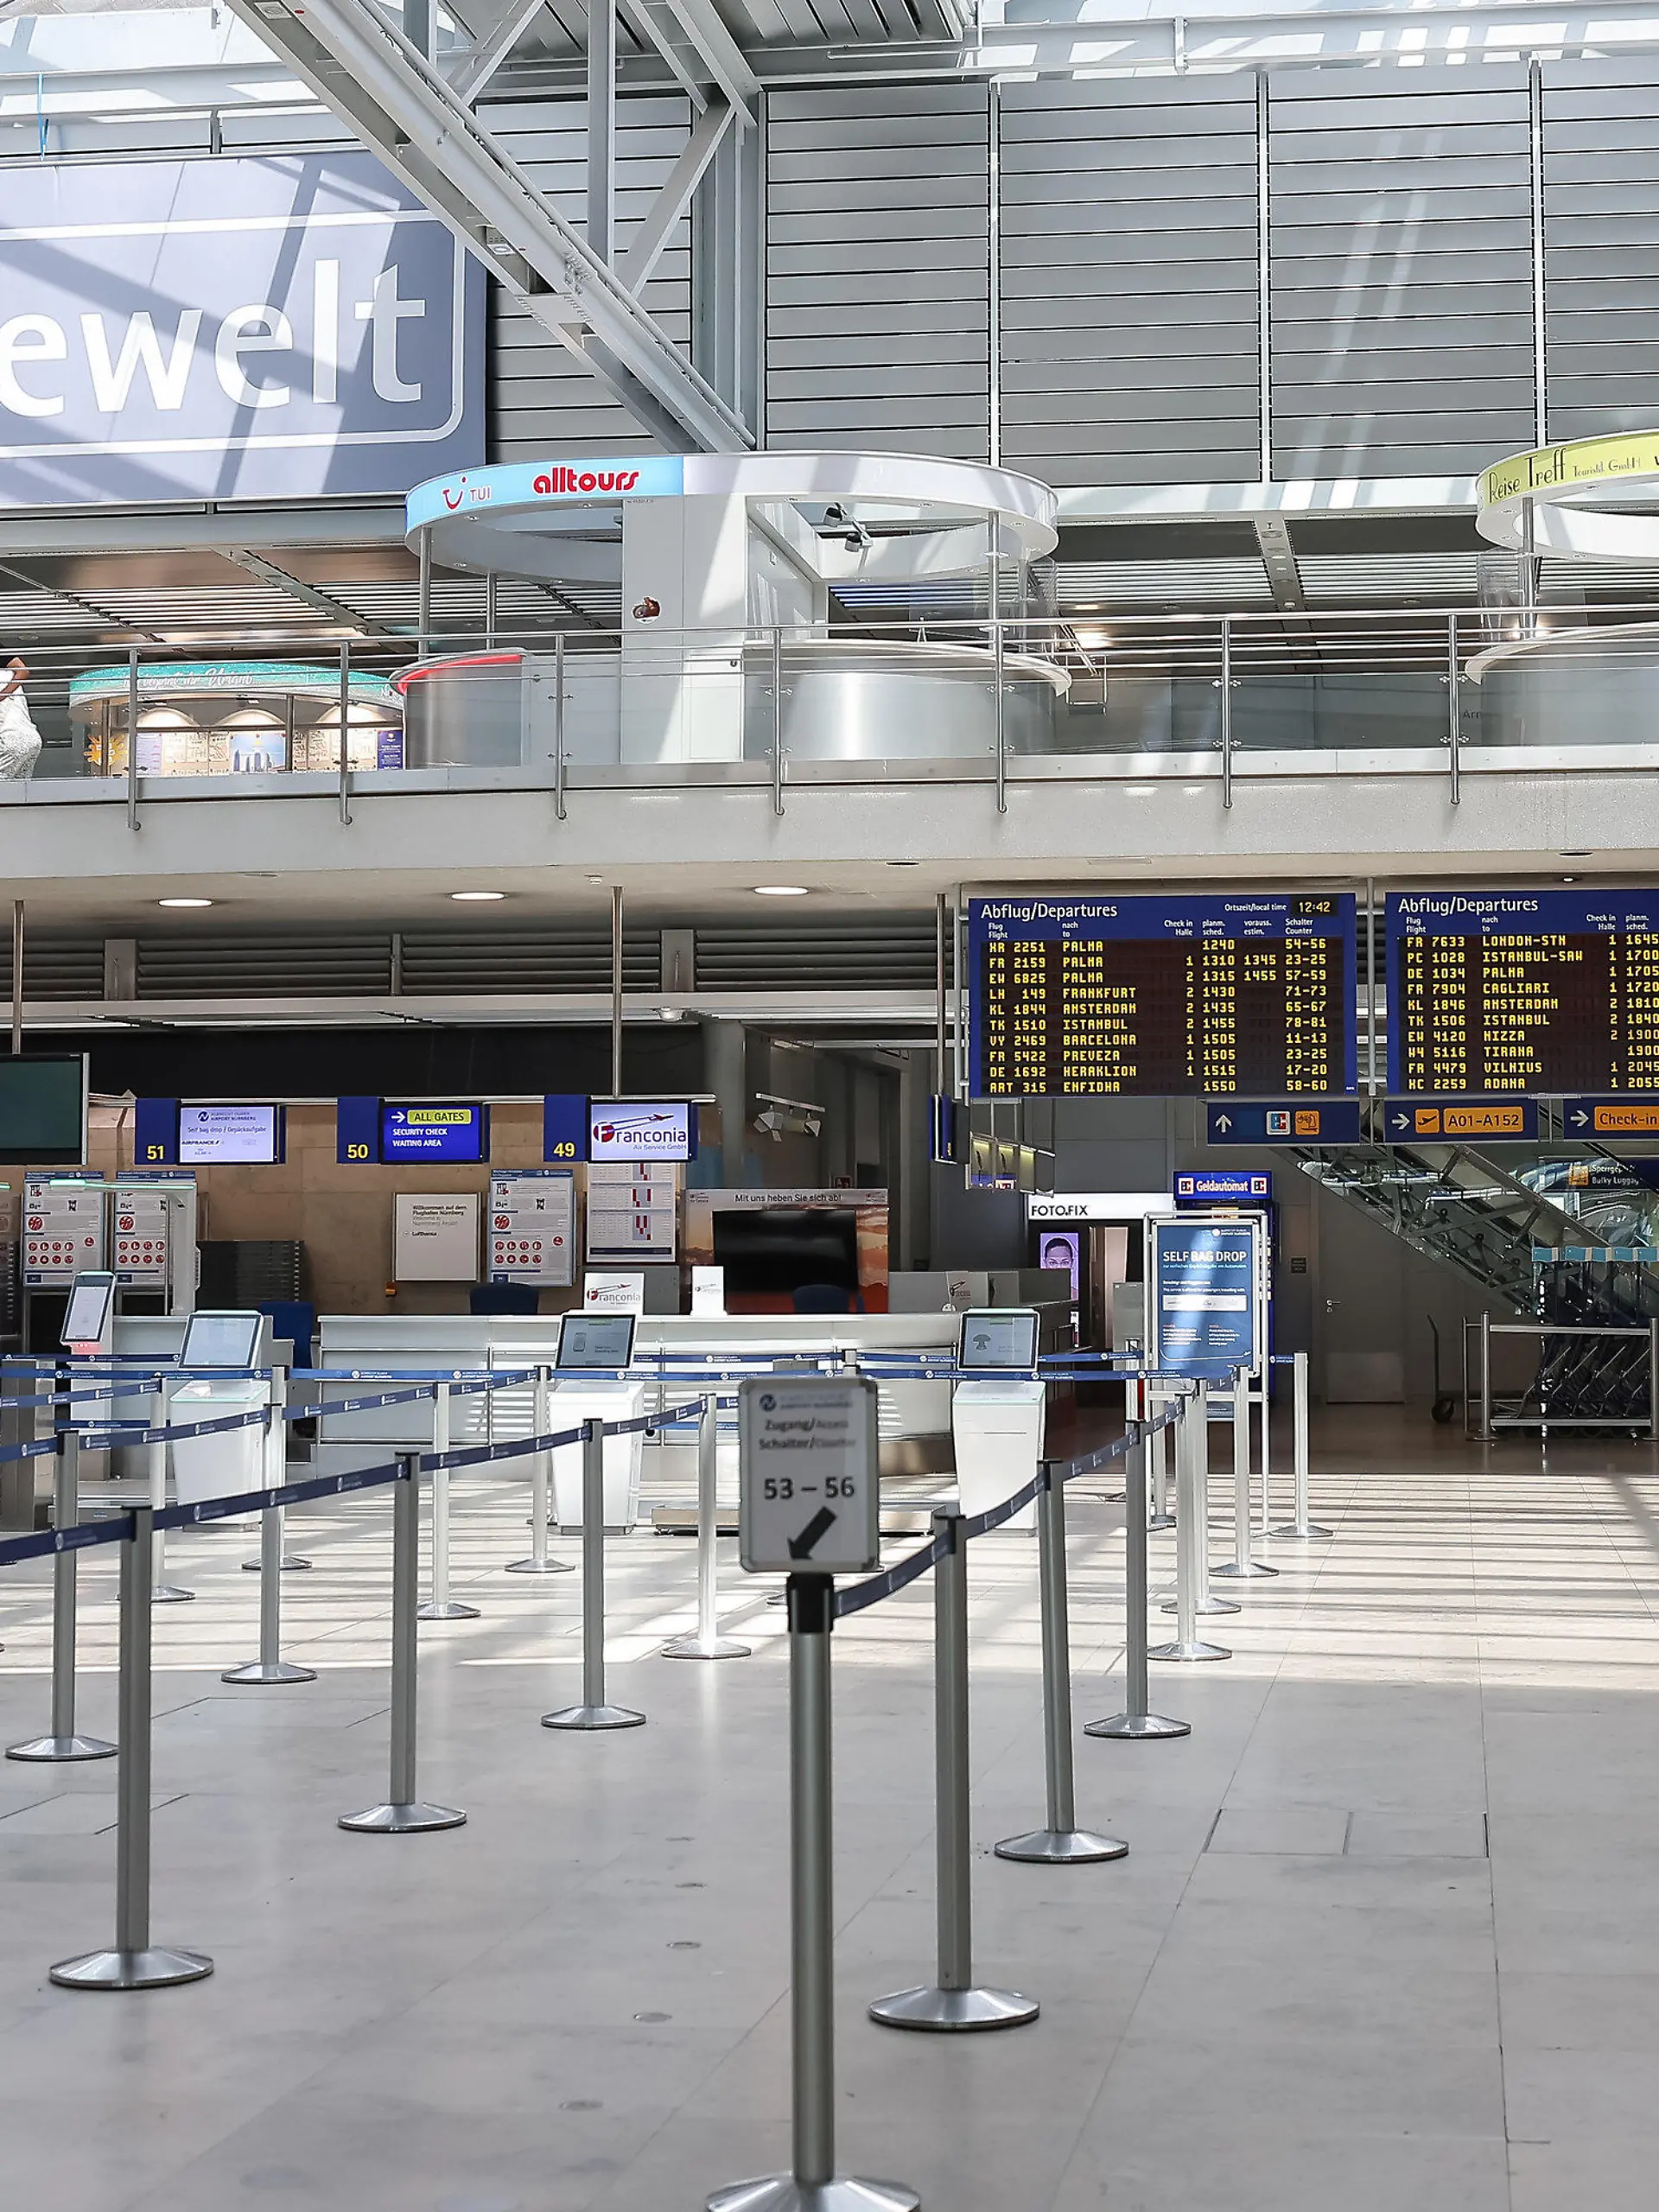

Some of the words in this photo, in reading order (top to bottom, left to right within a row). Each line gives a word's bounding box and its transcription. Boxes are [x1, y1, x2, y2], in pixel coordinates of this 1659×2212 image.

[0, 258, 426, 418] ewelt
[533, 467, 639, 494] alltours
[1489, 471, 1521, 504] Reise
[1524, 448, 1567, 487] Treff
[470, 485, 491, 501] TUI
[981, 902, 1117, 922] Abflug/Departures
[1299, 901, 1331, 912] 12:42
[1398, 897, 1538, 916] Abflug/Departures
[988, 923, 1003, 931] Flug
[988, 931, 1008, 939] Flight
[1407, 936, 1423, 948] FR
[1432, 936, 1465, 948] 7633
[1482, 934, 1566, 947] LONDON-STN
[1626, 933, 1659, 945] 1645
[1014, 941, 1046, 953] 2251
[1062, 940, 1103, 952] PALMA
[1202, 939, 1235, 950] 1240
[1285, 938, 1326, 950] 54-56
[989, 957, 1005, 969] FR
[1014, 957, 1046, 969] 2159
[1063, 956, 1103, 968] PALMA
[1203, 955, 1235, 966] 1310
[1243, 954, 1276, 965] 1345
[1285, 953, 1326, 965] 23-25
[1407, 952, 1423, 964] PC
[1432, 951, 1465, 963] 1028
[1482, 950, 1583, 963] ISTANBUL-SAW
[1626, 949, 1659, 961] 1700
[1014, 972, 1046, 984] 6825
[1063, 971, 1103, 983] PALMA
[1203, 970, 1236, 982] 1315
[1243, 969, 1276, 982] 1455
[1286, 969, 1326, 981] 57-59
[1407, 968, 1423, 979] DE
[1432, 967, 1465, 979] 1034
[1483, 967, 1524, 979] PALMA
[1626, 965, 1659, 976] 1705
[989, 988, 1005, 1000] LH
[1022, 988, 1046, 1000] 149
[1063, 987, 1136, 1000] FRANKFURT
[1203, 986, 1236, 997] 1430
[1286, 985, 1326, 997] 71-73
[1408, 983, 1423, 995] FR
[1433, 983, 1465, 995] 7904
[1483, 982, 1549, 995] CAGLIARI
[1626, 981, 1659, 993] 1720
[989, 1004, 1005, 1015] KL
[1014, 1003, 1046, 1015] 1844
[1063, 1002, 1136, 1015] AMSTERDAM
[1203, 1001, 1236, 1014] 1435
[1286, 1001, 1327, 1013] 65-67
[1408, 999, 1424, 1011] KL
[1433, 999, 1465, 1011] 1846
[1483, 998, 1558, 1010] AMSTERDAM
[1626, 997, 1659, 1008] 1810
[989, 1020, 1005, 1031] TK
[1014, 1019, 1046, 1031] 1510
[1063, 1018, 1128, 1031] ISTANBUL
[1203, 1017, 1236, 1029] 1455
[1286, 1016, 1327, 1028] 78-81
[1408, 1014, 1424, 1027] TK
[1433, 1014, 1465, 1027] 1506
[1483, 1014, 1550, 1026] ISTANBUL
[1627, 1013, 1659, 1025] 1840
[989, 1035, 1005, 1046] VY
[1014, 1034, 1046, 1046] 2469
[1063, 1033, 1136, 1046] BARCELONA
[1203, 1033, 1236, 1045] 1505
[1286, 1032, 1327, 1044] 11-13
[1433, 1030, 1466, 1042] 4120
[1484, 1030, 1525, 1042] NIZZA
[1627, 1029, 1659, 1040] 1900
[989, 1051, 1005, 1063] FR
[1014, 1051, 1046, 1062] 5422
[1063, 1050, 1120, 1062] PREVEZA
[1203, 1049, 1236, 1060] 1505
[1286, 1048, 1327, 1059] 23-25
[1433, 1046, 1466, 1058] 5116
[1484, 1046, 1534, 1058] TIRANA
[1627, 1045, 1659, 1056] 1900
[989, 1066, 1005, 1077] DE
[1014, 1066, 1046, 1077] 1692
[1063, 1065, 1137, 1077] HERAKLION
[1204, 1065, 1236, 1076] 1515
[1286, 1064, 1327, 1076] 17-20
[1408, 1063, 1425, 1074] FR
[1433, 1062, 1466, 1074] 4479
[1484, 1062, 1542, 1073] VILNIUS
[1627, 1060, 1659, 1072] 2045
[989, 1082, 1014, 1094] ART
[1022, 1082, 1046, 1093] 315
[1063, 1081, 1120, 1093] ENFIDHA
[1204, 1080, 1236, 1092] 1550
[1287, 1079, 1327, 1091] 58-60
[1433, 1078, 1466, 1090] 2259
[1484, 1077, 1525, 1090] ADANA
[1628, 1077, 1659, 1088] 2055
[414, 1112, 431, 1122] ALL
[434, 1112, 464, 1122] GATES
[1448, 1113, 1519, 1127] A01-A152
[1599, 1112, 1658, 1126] Check-in
[594, 1122, 687, 1142] Franconia
[146, 1145, 165, 1160] 51
[347, 1144, 368, 1160] 50
[553, 1142, 575, 1158] 49
[1196, 1180, 1249, 1193] Geldautomat
[1592, 1176, 1612, 1185] Bulky
[1613, 1176, 1642, 1185] Luggag
[1163, 1251, 1190, 1262] SELF
[1216, 1251, 1247, 1262] DROP
[587, 1288, 640, 1301] Franconia
[764, 1478, 794, 1500] 53
[825, 1476, 855, 1498] 56
